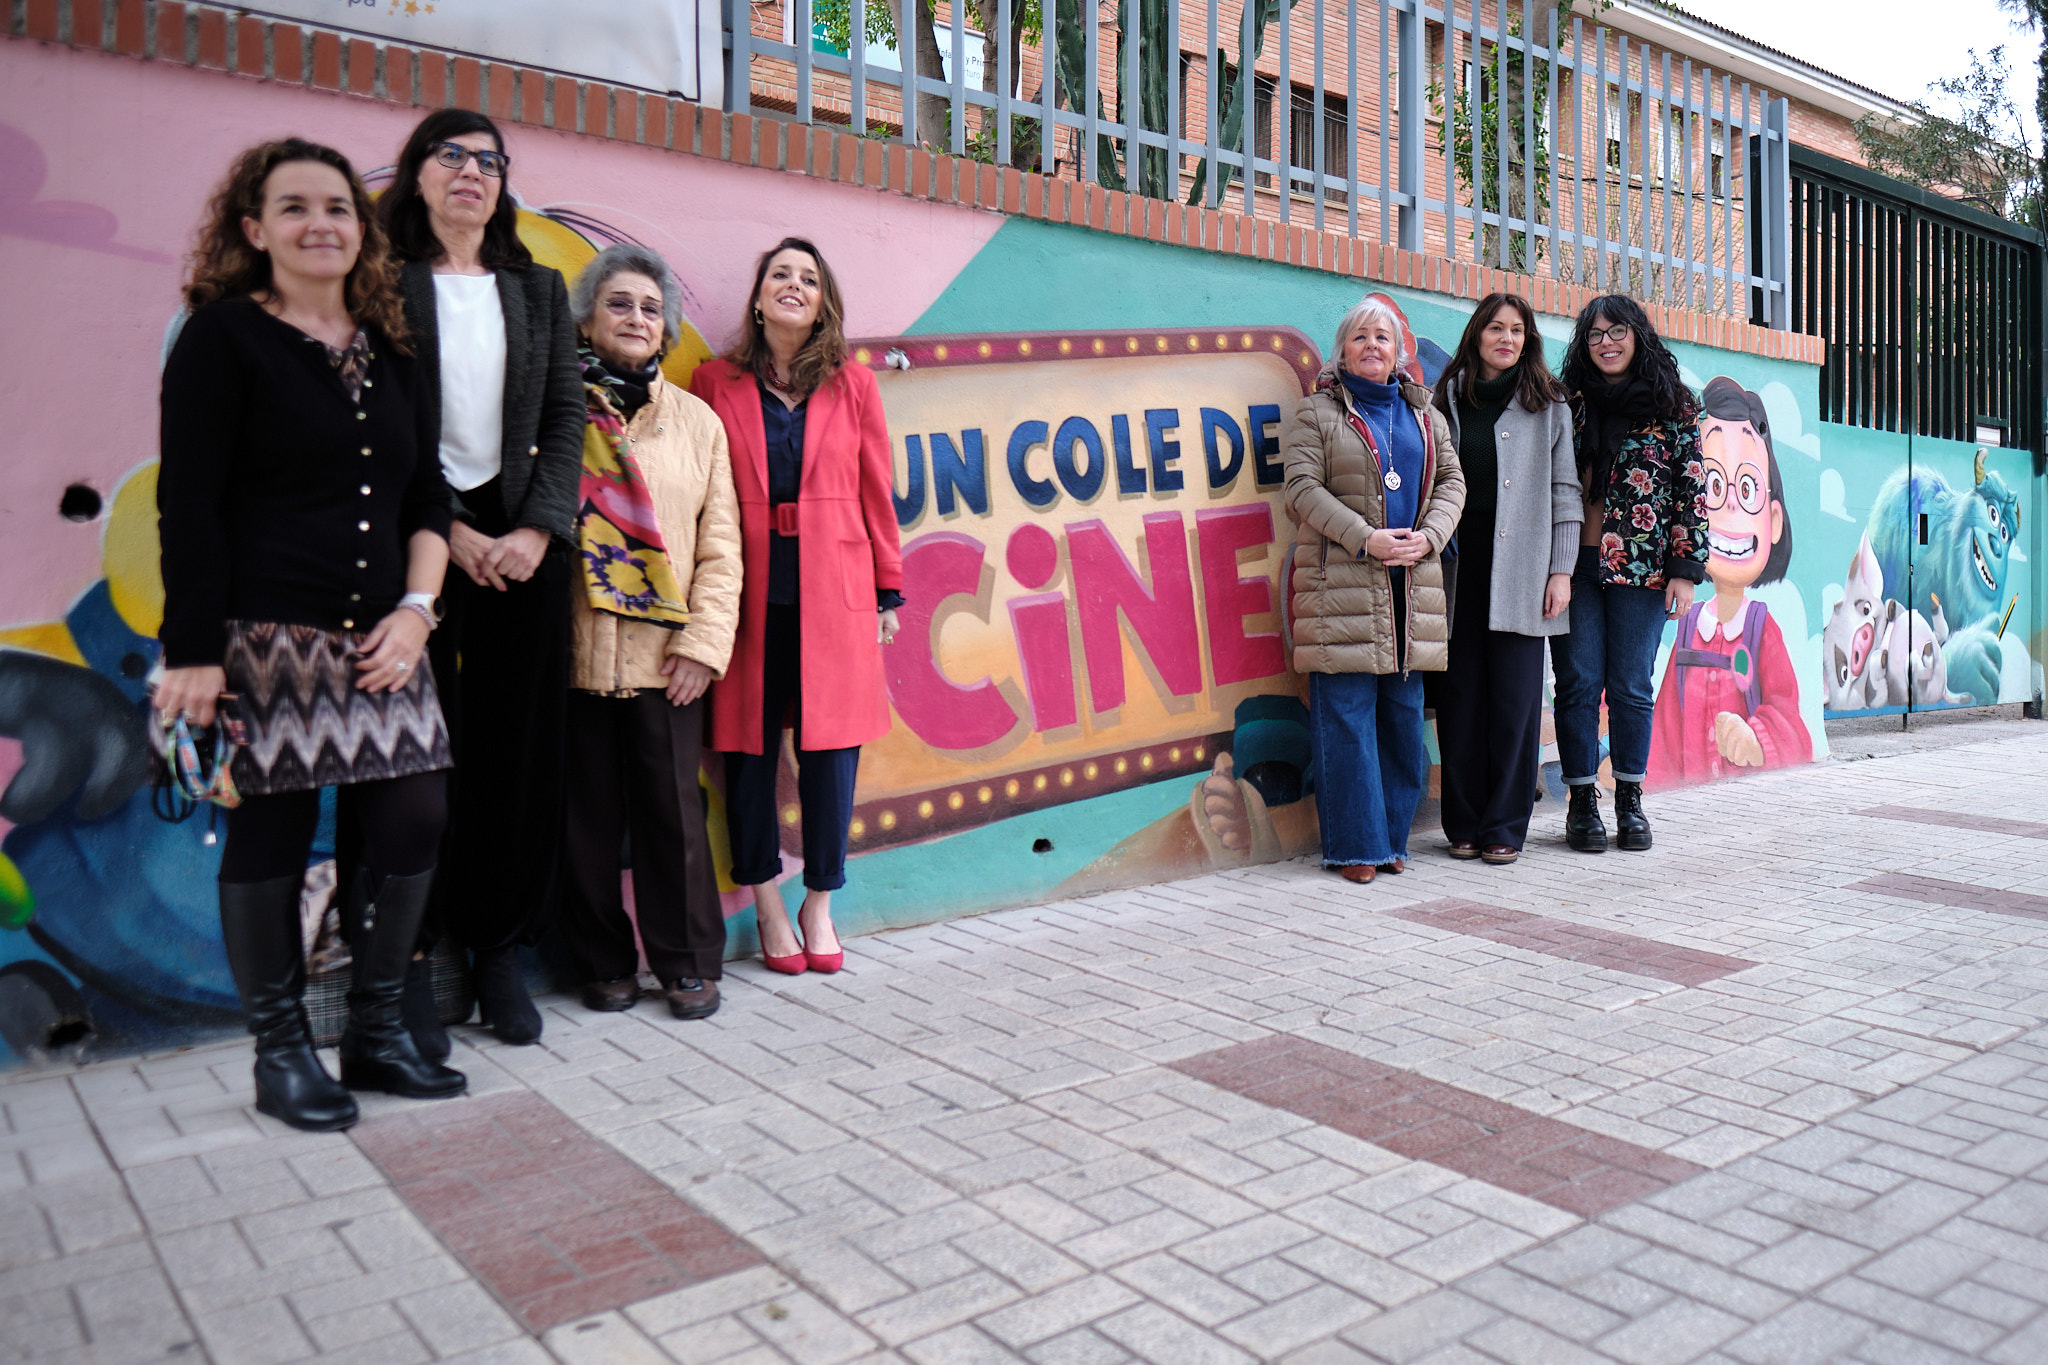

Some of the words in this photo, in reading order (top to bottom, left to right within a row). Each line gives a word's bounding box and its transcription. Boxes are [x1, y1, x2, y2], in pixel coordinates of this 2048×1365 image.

[892, 428, 989, 527] UN
[1006, 408, 1185, 506] COLE
[1200, 403, 1285, 489] DE
